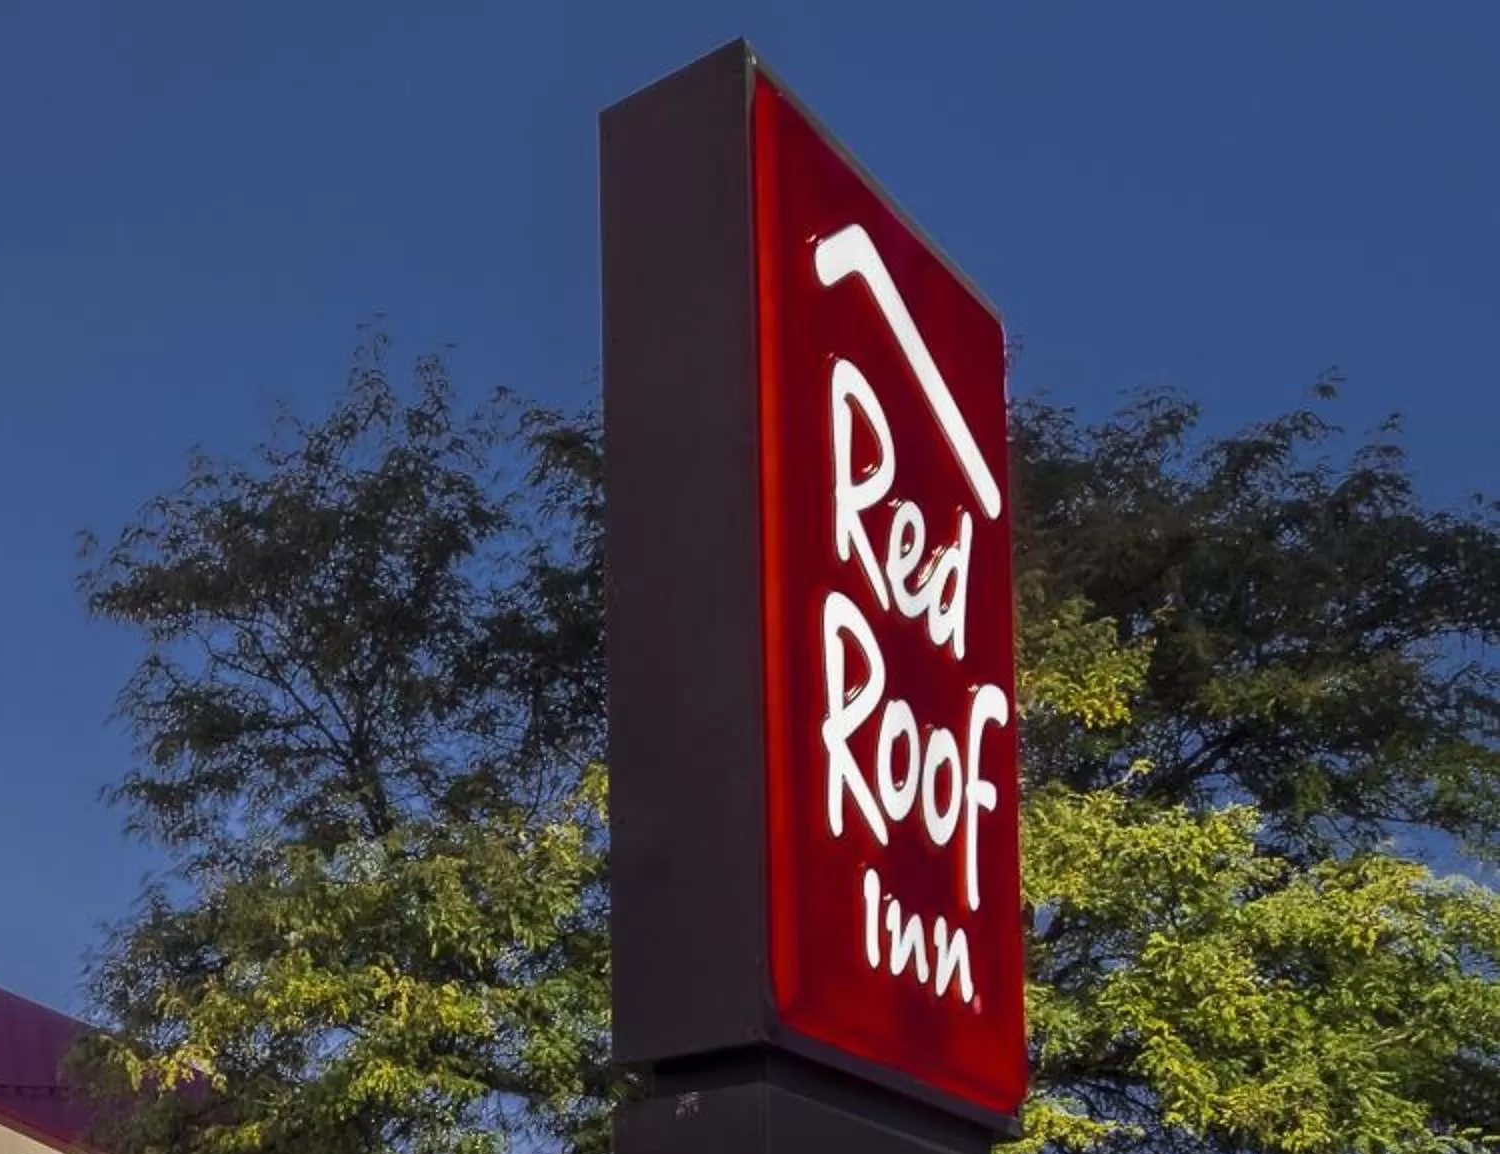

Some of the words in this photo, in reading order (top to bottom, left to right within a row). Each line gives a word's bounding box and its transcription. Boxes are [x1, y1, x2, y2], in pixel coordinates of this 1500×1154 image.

[831, 358, 974, 660] Red
[821, 591, 1009, 911] Roof
[863, 868, 974, 1003] Inn
